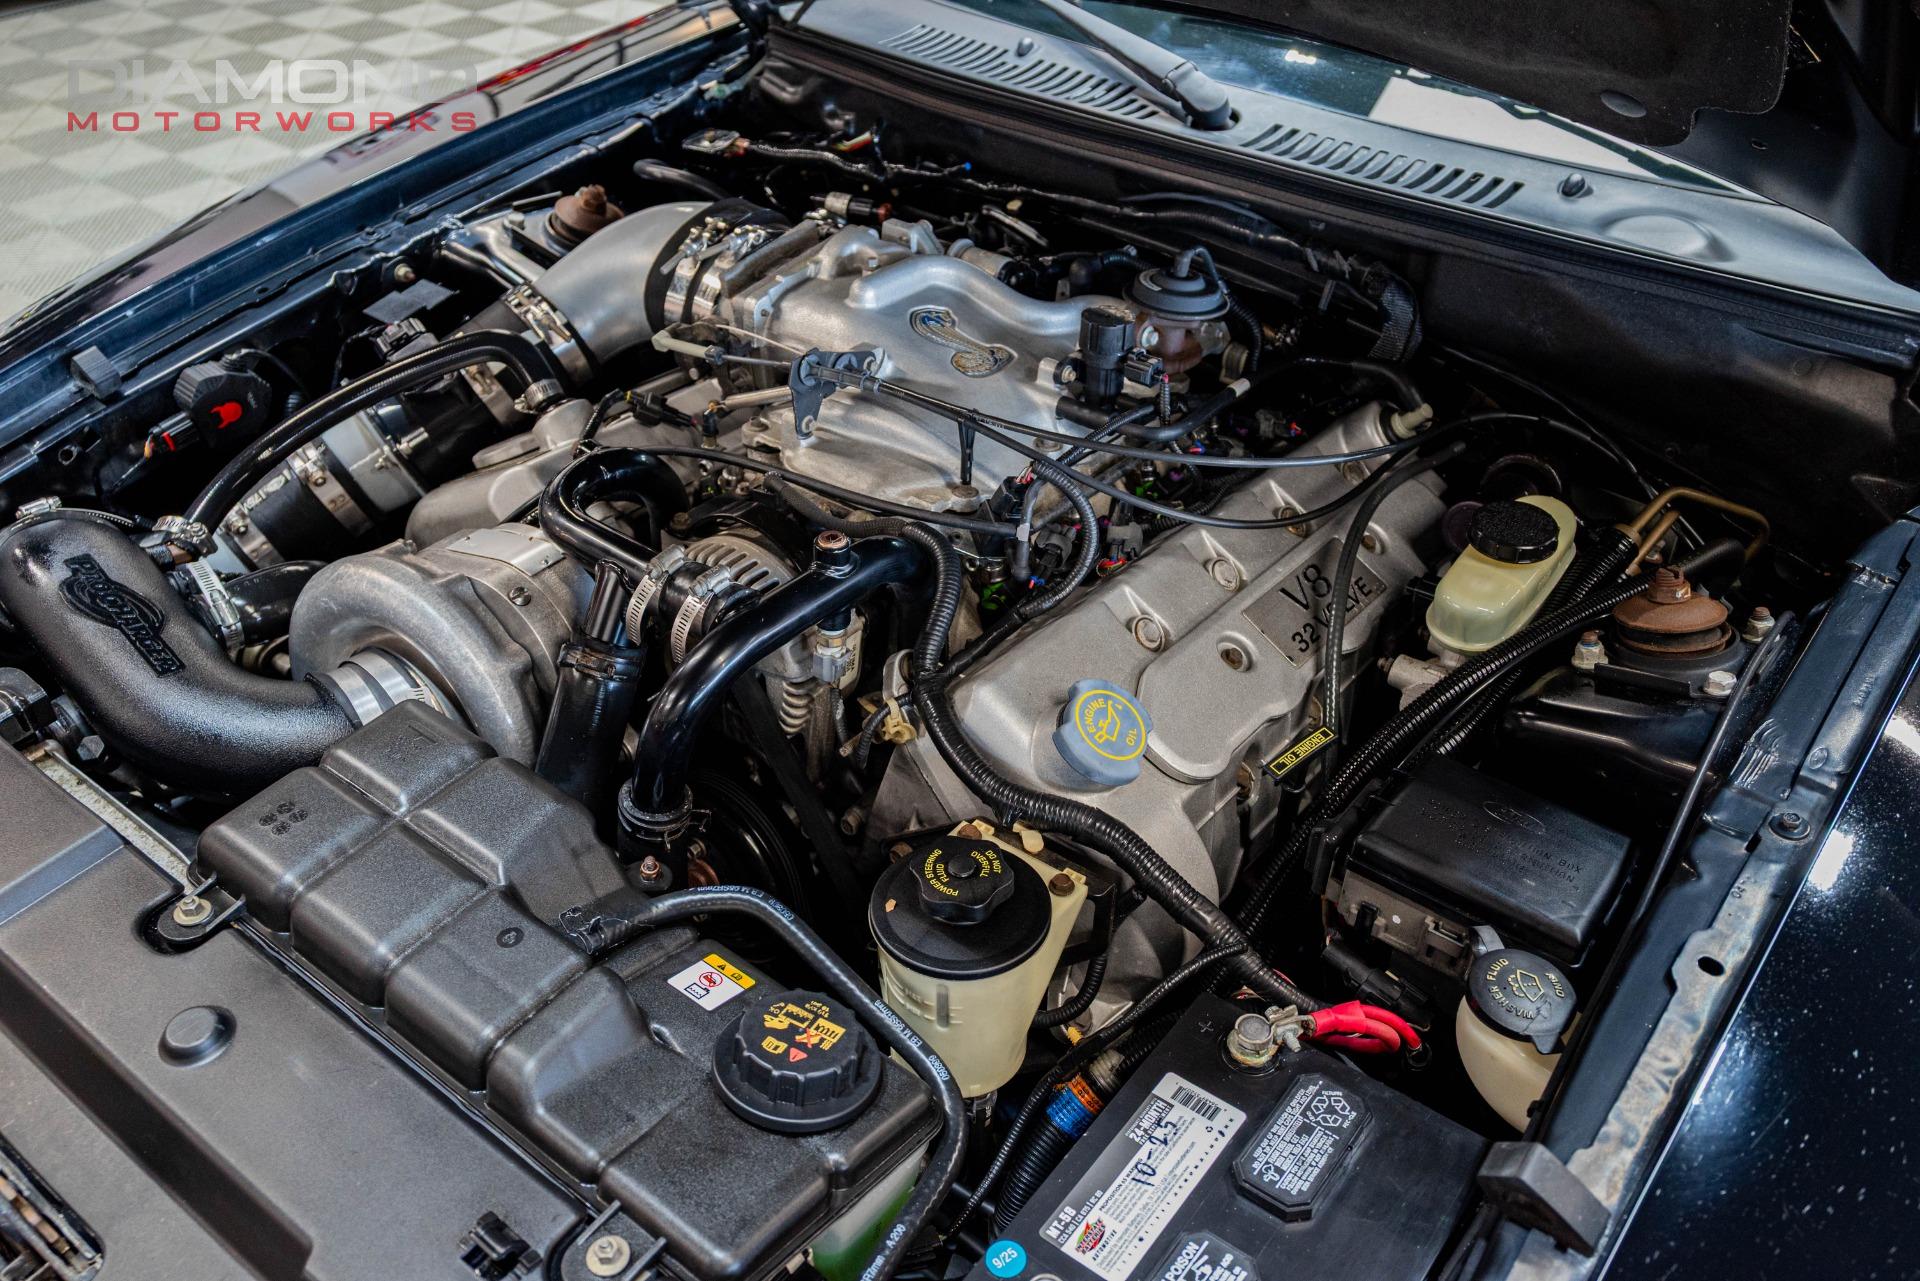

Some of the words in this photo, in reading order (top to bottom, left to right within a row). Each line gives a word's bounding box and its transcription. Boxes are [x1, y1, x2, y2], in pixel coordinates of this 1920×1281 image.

[1279, 563, 1333, 611] V8
[1291, 622, 1322, 653] 32
[1313, 576, 1373, 629] VLVE
[1084, 698, 1106, 733] ENGINE
[1126, 728, 1137, 746] OIL
[1294, 733, 1326, 756] ENGINE
[1279, 754, 1296, 765] OIL
[924, 848, 942, 879] STEERING
[936, 863, 950, 883] FLUID
[970, 850, 991, 878] OVERFILL
[985, 849, 997, 860] DO
[992, 859, 1002, 874] NOT
[930, 878, 959, 897] POWER
[1487, 958, 1509, 981] FLUID
[1544, 972, 1565, 998] ONLY
[1488, 985, 1535, 1020] WASHER
[1129, 1098, 1168, 1143] 24-MONTH
[1261, 1138, 1269, 1147] OUT
[1299, 1134, 1309, 1145] FAST
[1099, 1184, 1122, 1211] PROPOSITION
[1046, 1205, 1077, 1239] MT-58
[1075, 1219, 1103, 1251] INTERSTATE
[1081, 1224, 1107, 1254] BATTERIES
[1092, 1229, 1118, 1262] AUTOMOTIVE
[992, 1247, 1018, 1269] 9/25
[1165, 1241, 1199, 1279] POISON
